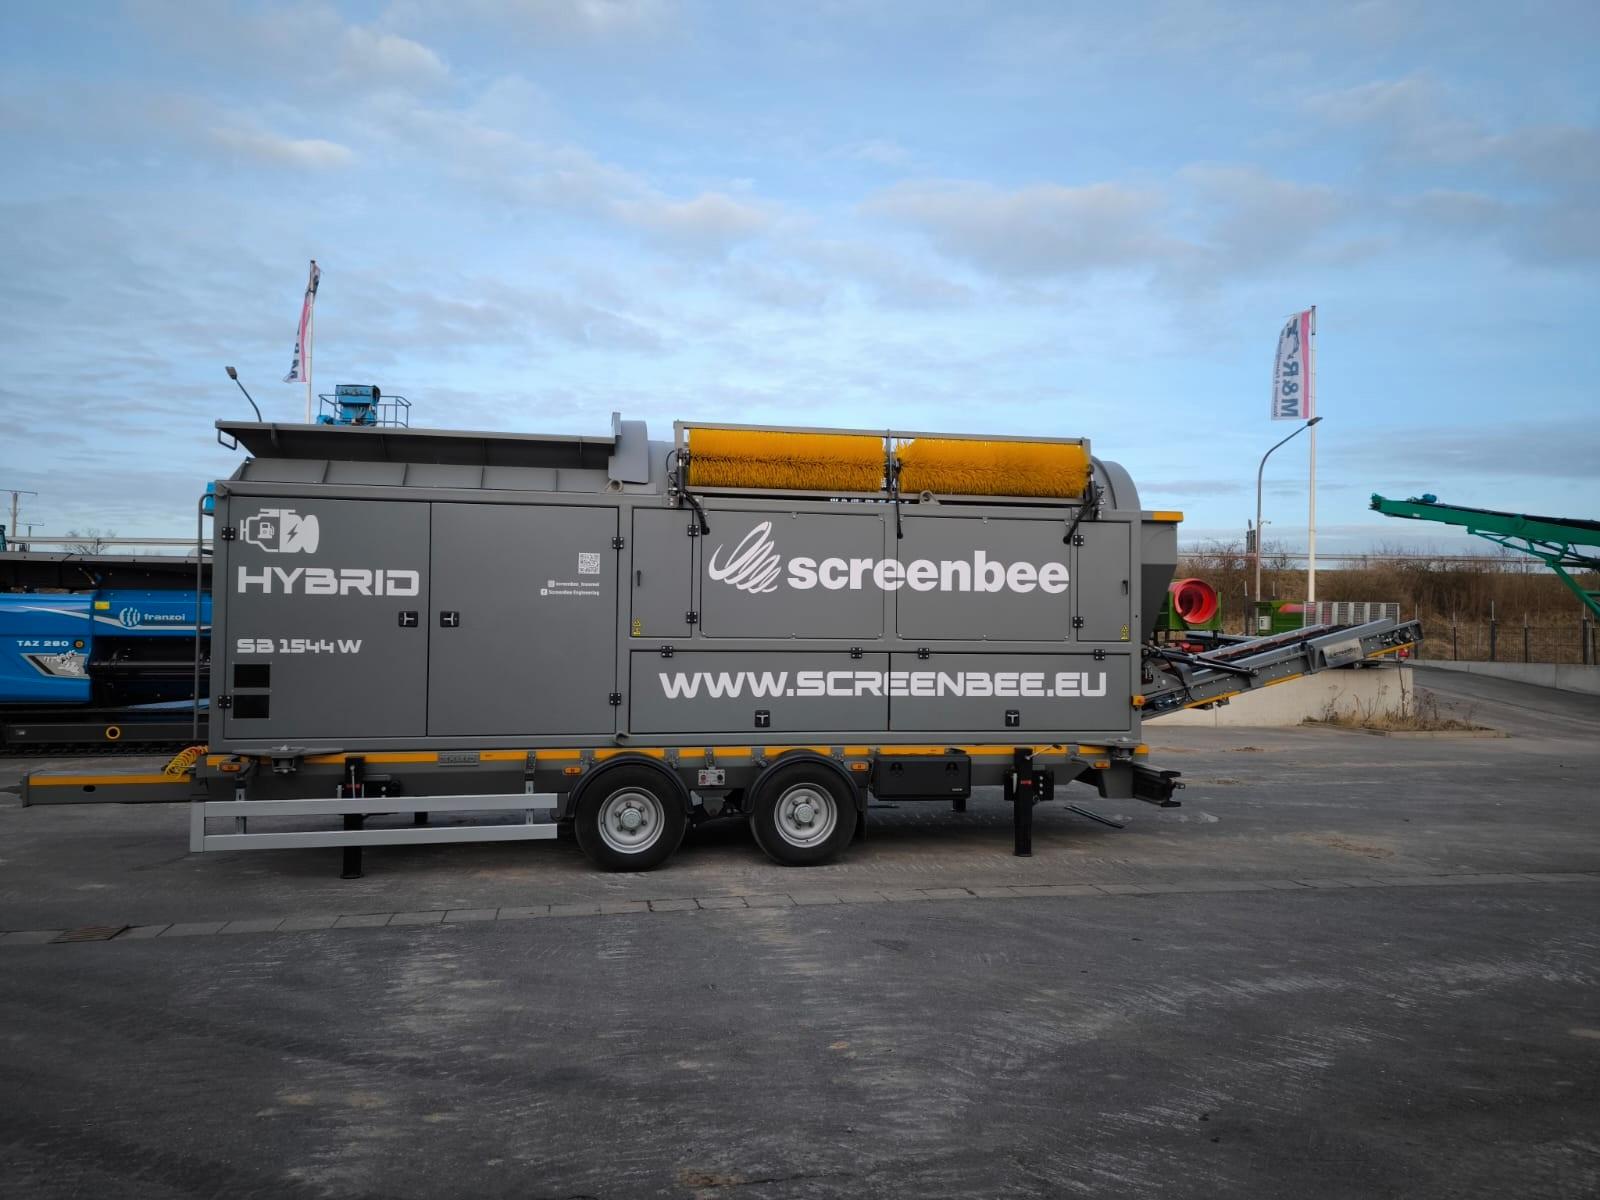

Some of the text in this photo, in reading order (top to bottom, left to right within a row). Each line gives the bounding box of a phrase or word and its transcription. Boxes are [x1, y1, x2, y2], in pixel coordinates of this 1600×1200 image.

[237, 566, 420, 597] HYBRID
[787, 549, 1070, 594] screenbee
[144, 613, 186, 622] franzoi
[237, 638, 275, 653] SB
[658, 670, 1107, 699] WWW.SCREENBEE.EU
